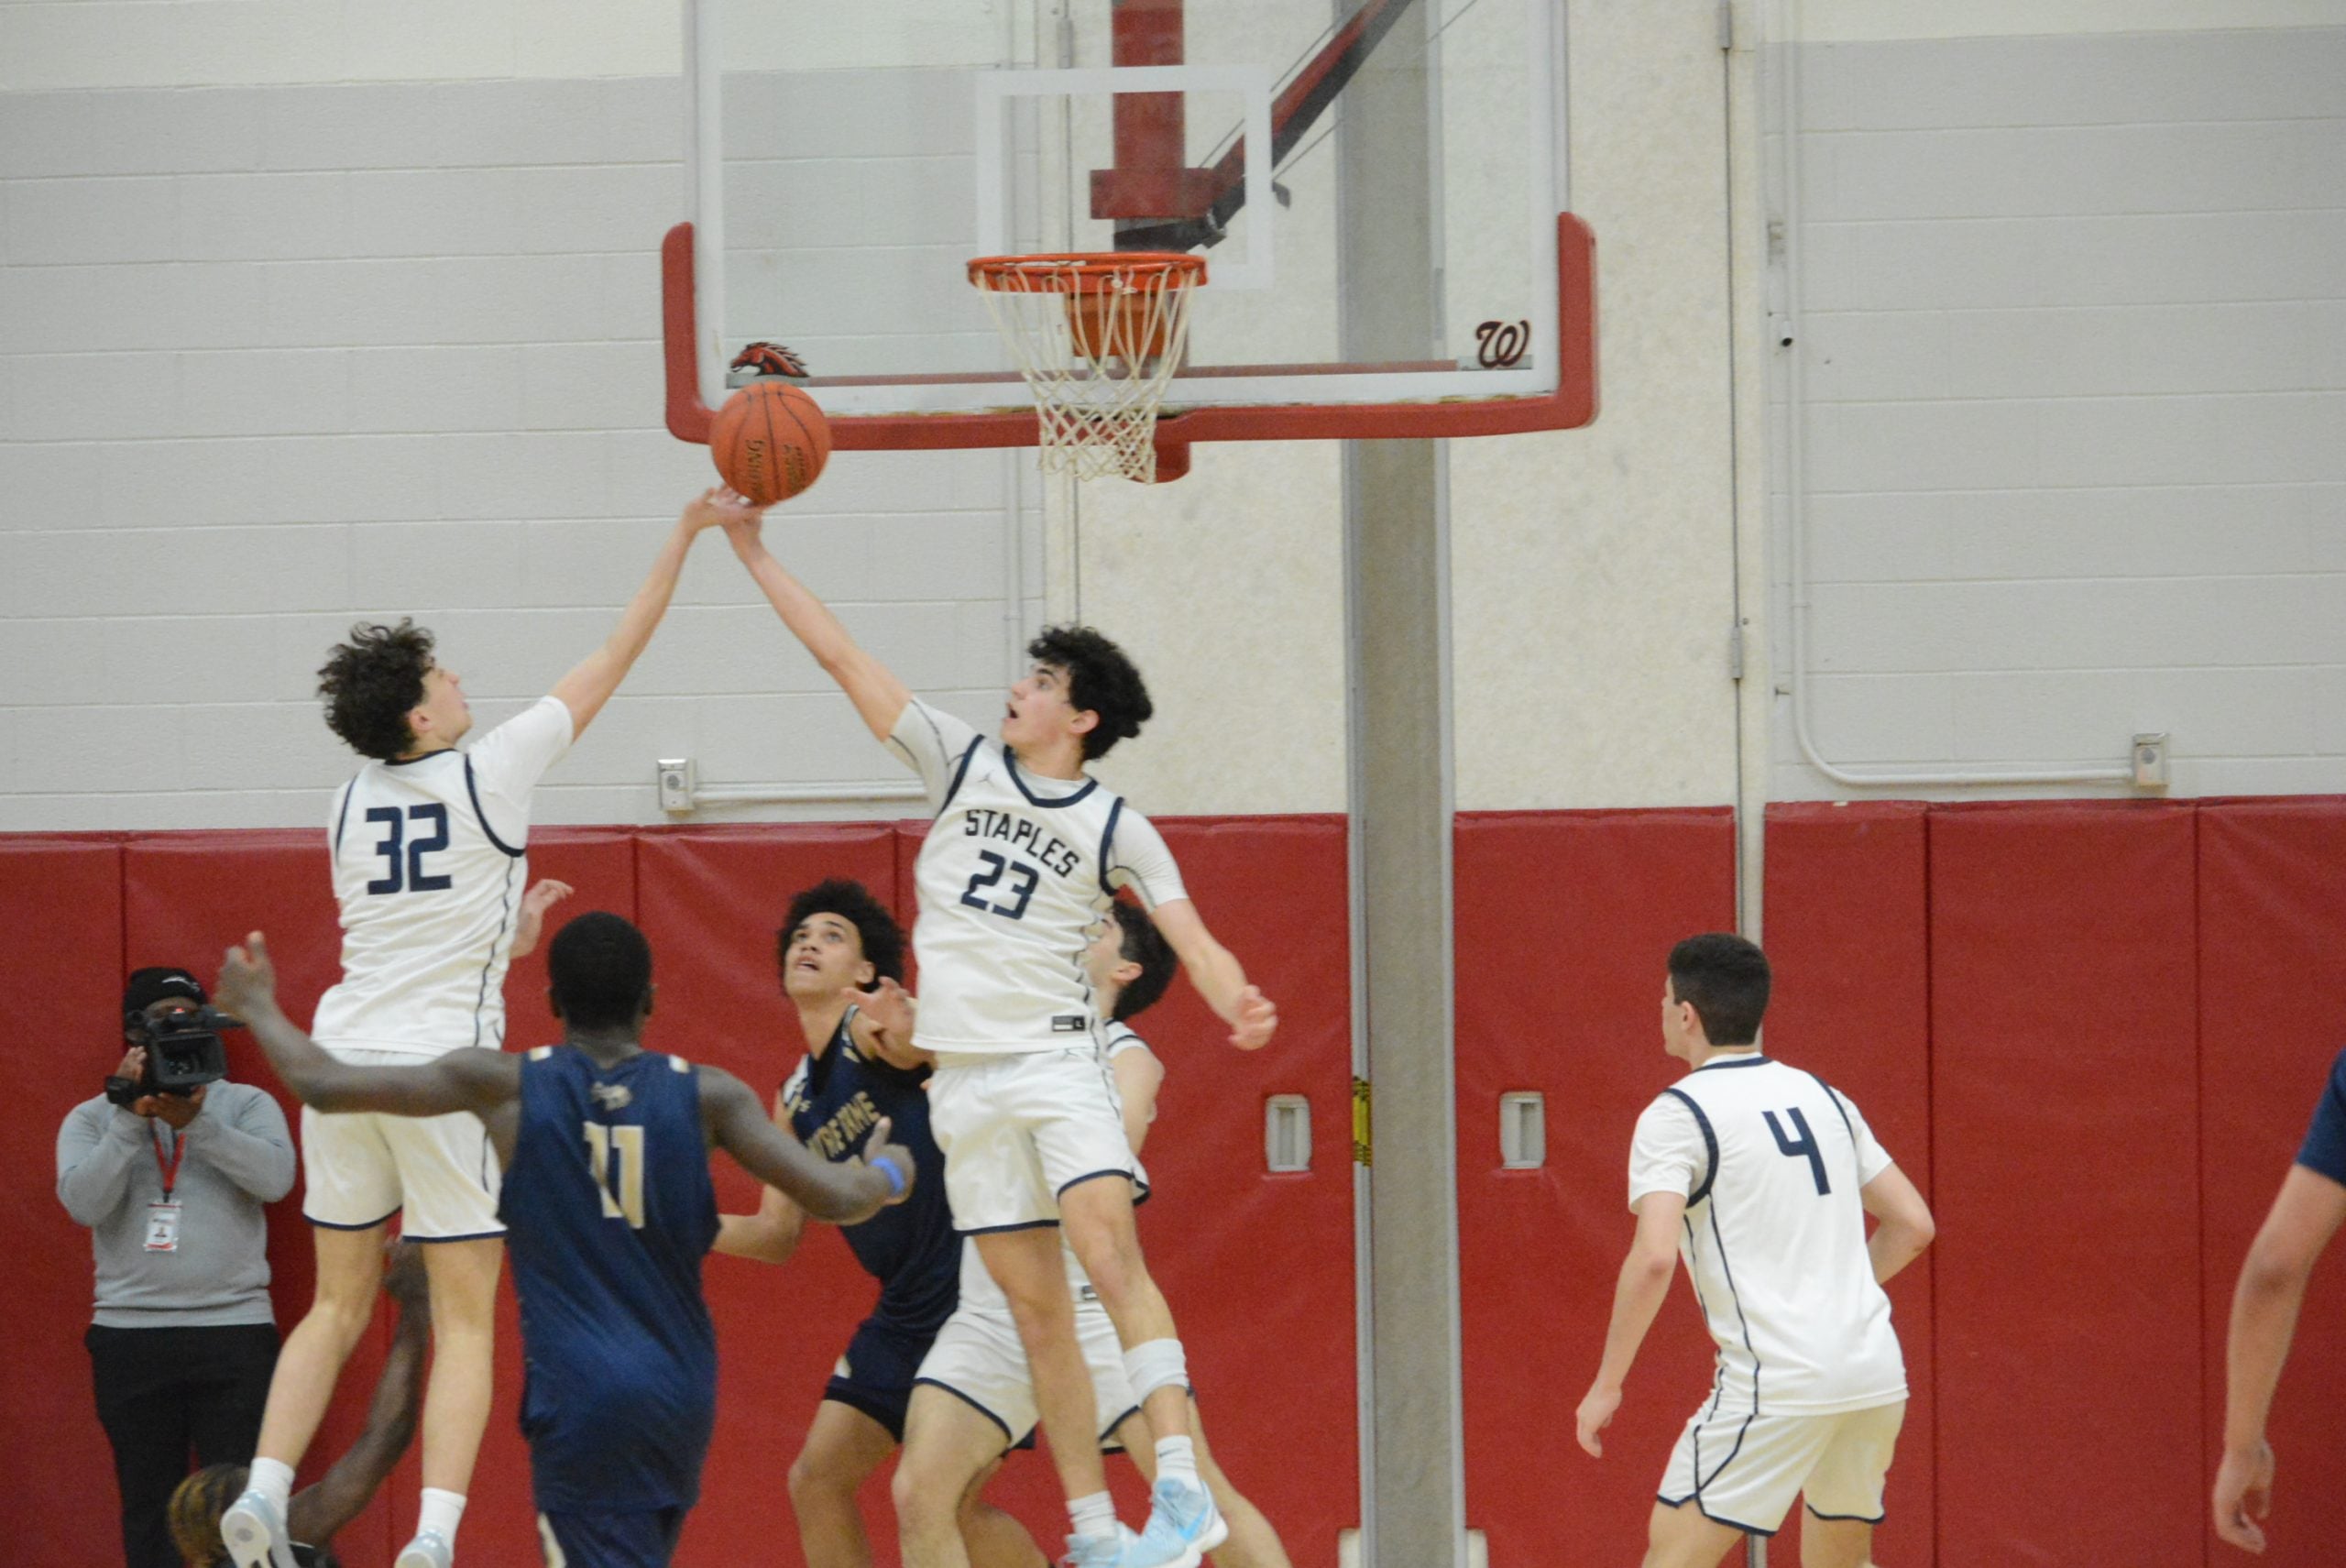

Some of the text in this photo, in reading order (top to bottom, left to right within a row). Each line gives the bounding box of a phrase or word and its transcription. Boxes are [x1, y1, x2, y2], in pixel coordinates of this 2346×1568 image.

[1475, 320, 1530, 368] W
[365, 803, 452, 895] 32
[965, 809, 1080, 878] STAPLES
[960, 850, 1039, 920] 23
[1761, 1107, 1831, 1196] 4
